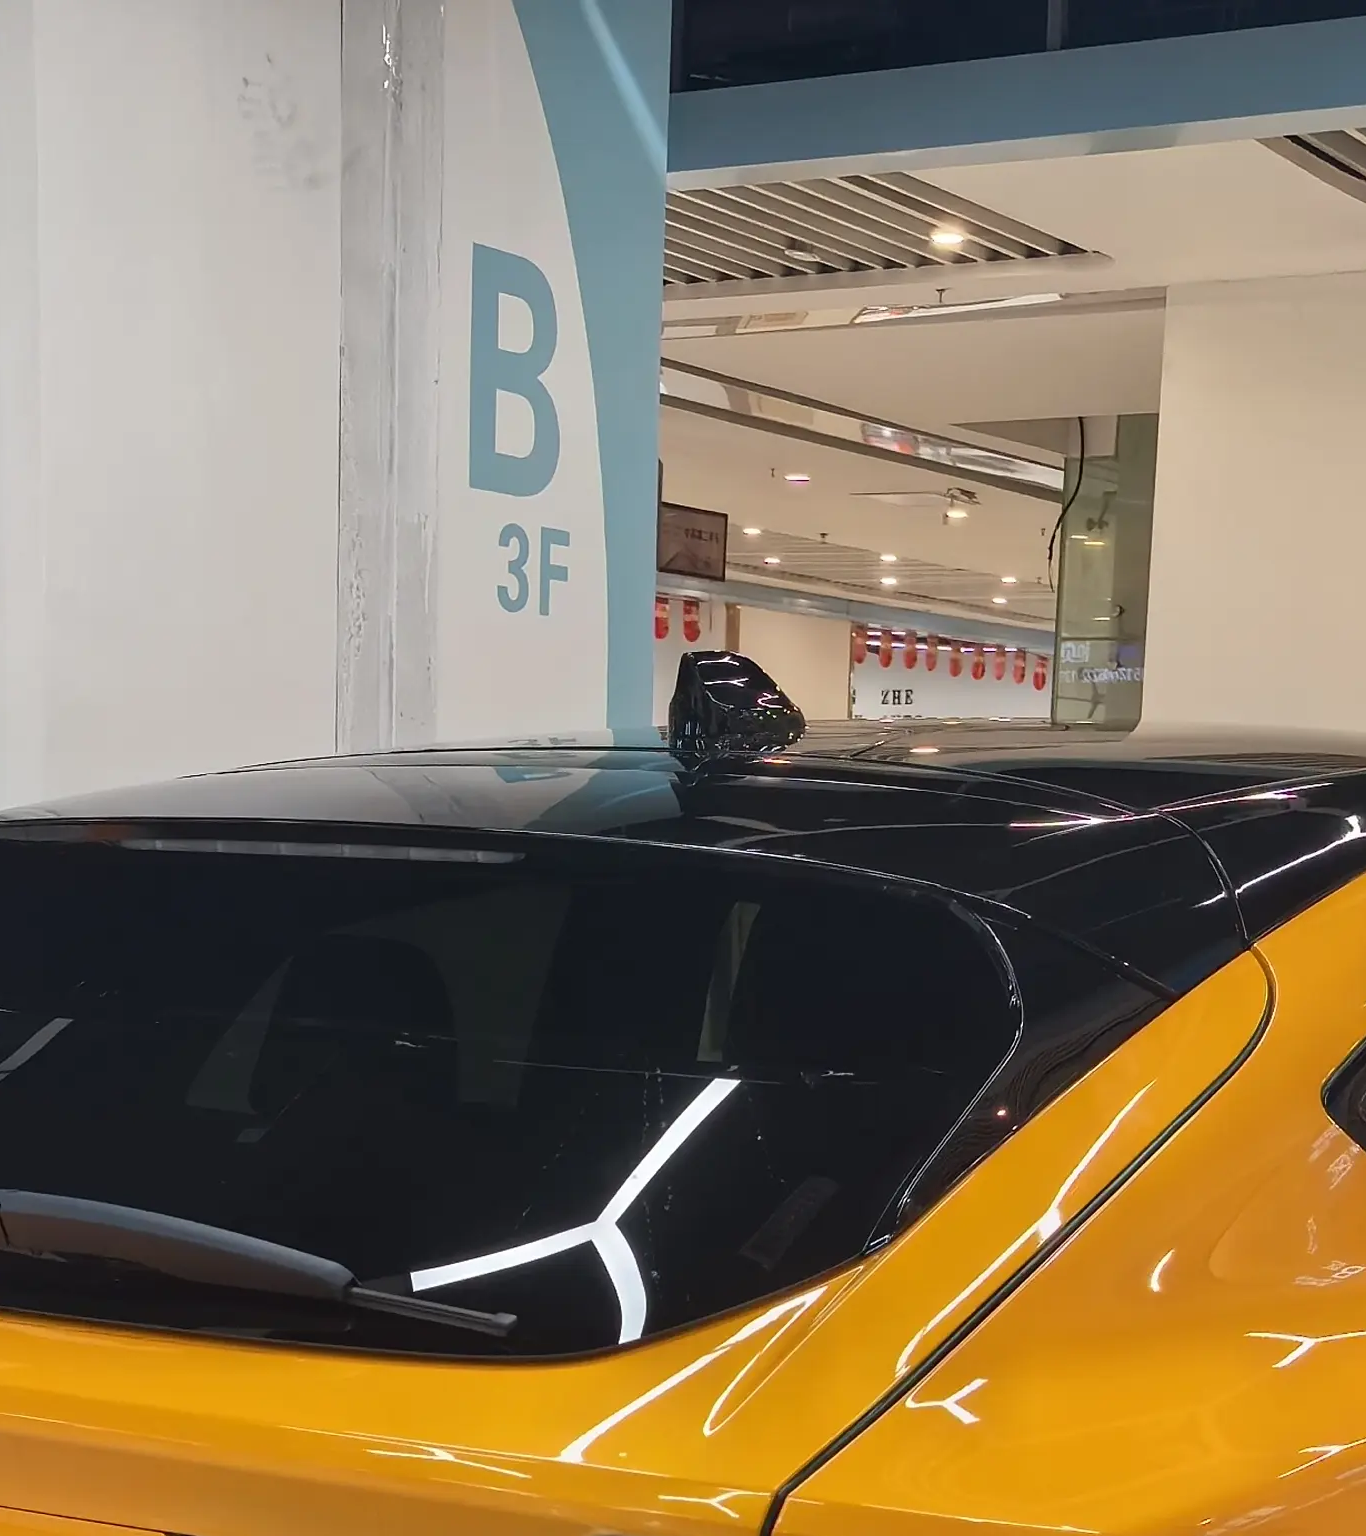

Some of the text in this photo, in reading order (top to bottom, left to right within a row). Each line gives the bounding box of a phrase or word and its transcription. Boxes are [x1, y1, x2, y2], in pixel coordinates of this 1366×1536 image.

[469, 241, 561, 498] B
[496, 522, 570, 616] 3F
[881, 689, 914, 705] ZHE
